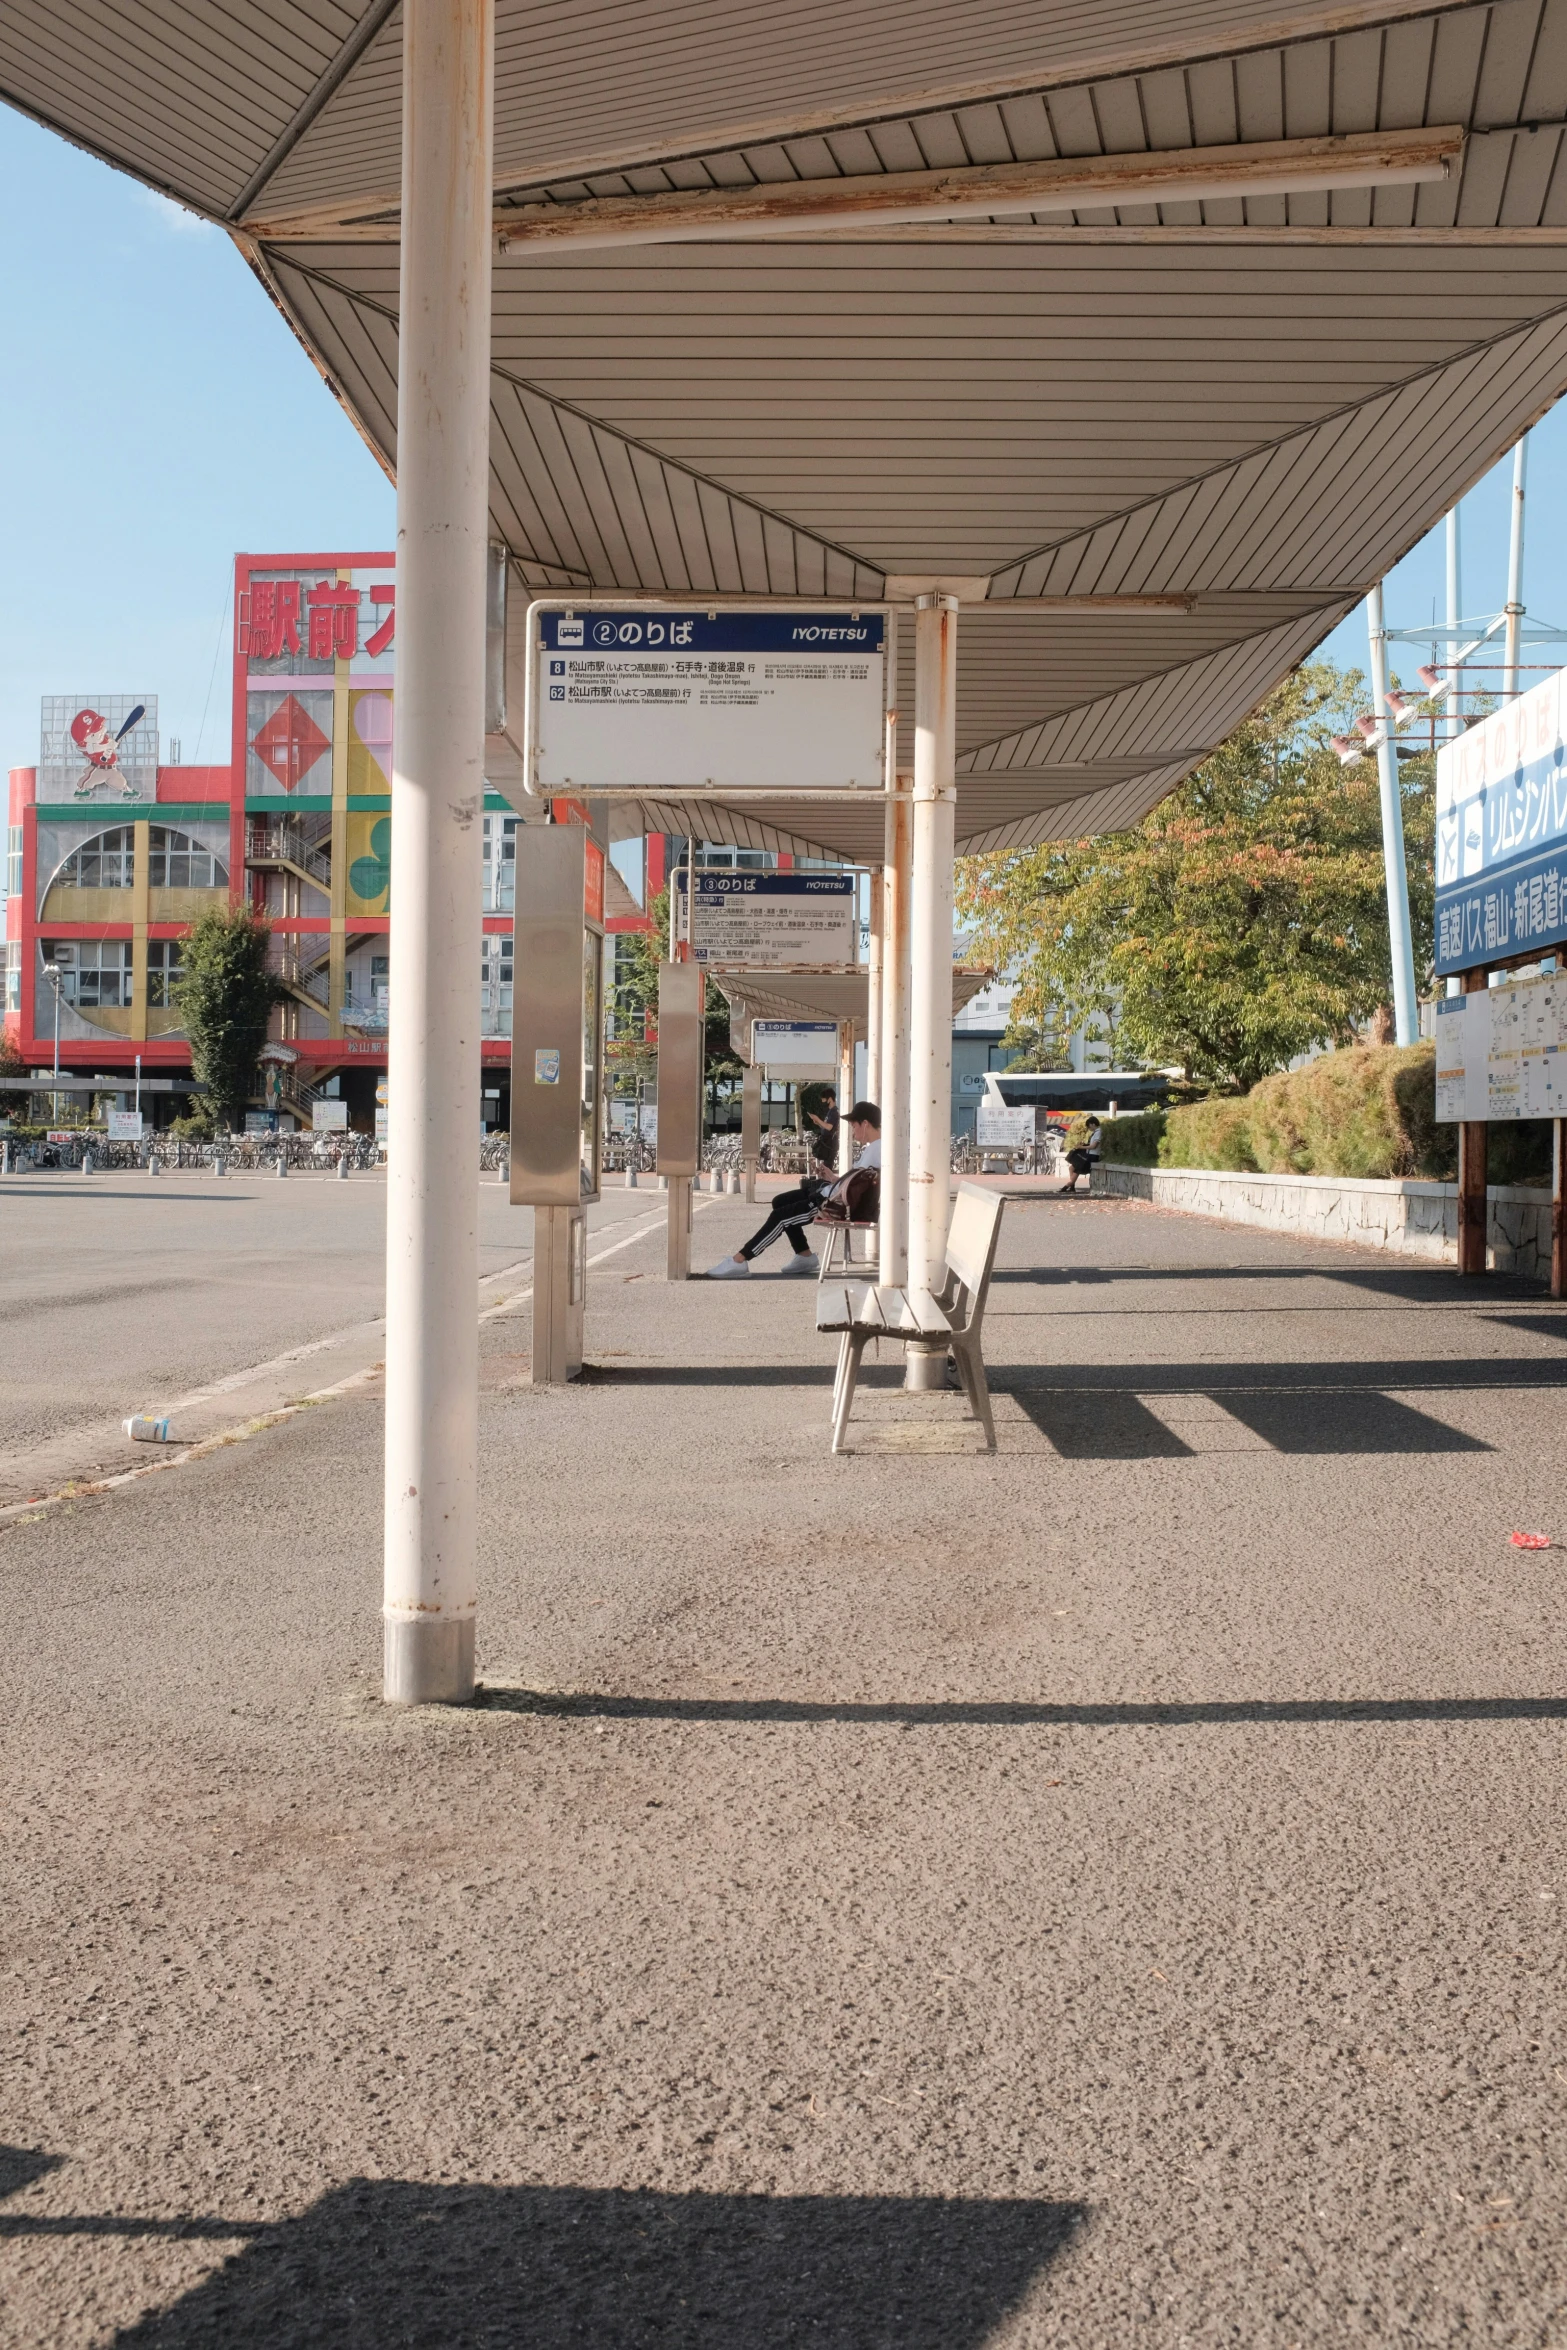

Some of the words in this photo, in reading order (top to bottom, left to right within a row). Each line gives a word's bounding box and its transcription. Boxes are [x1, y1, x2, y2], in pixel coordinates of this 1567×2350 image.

[792, 626, 867, 641] IYOTETSU
[554, 662, 561, 674] 8
[748, 664, 756, 672] 行
[550, 688, 564, 698] 62
[682, 689, 692, 698] 行
[82, 715, 93, 726] S
[806, 881, 845, 890] IYOTETSU
